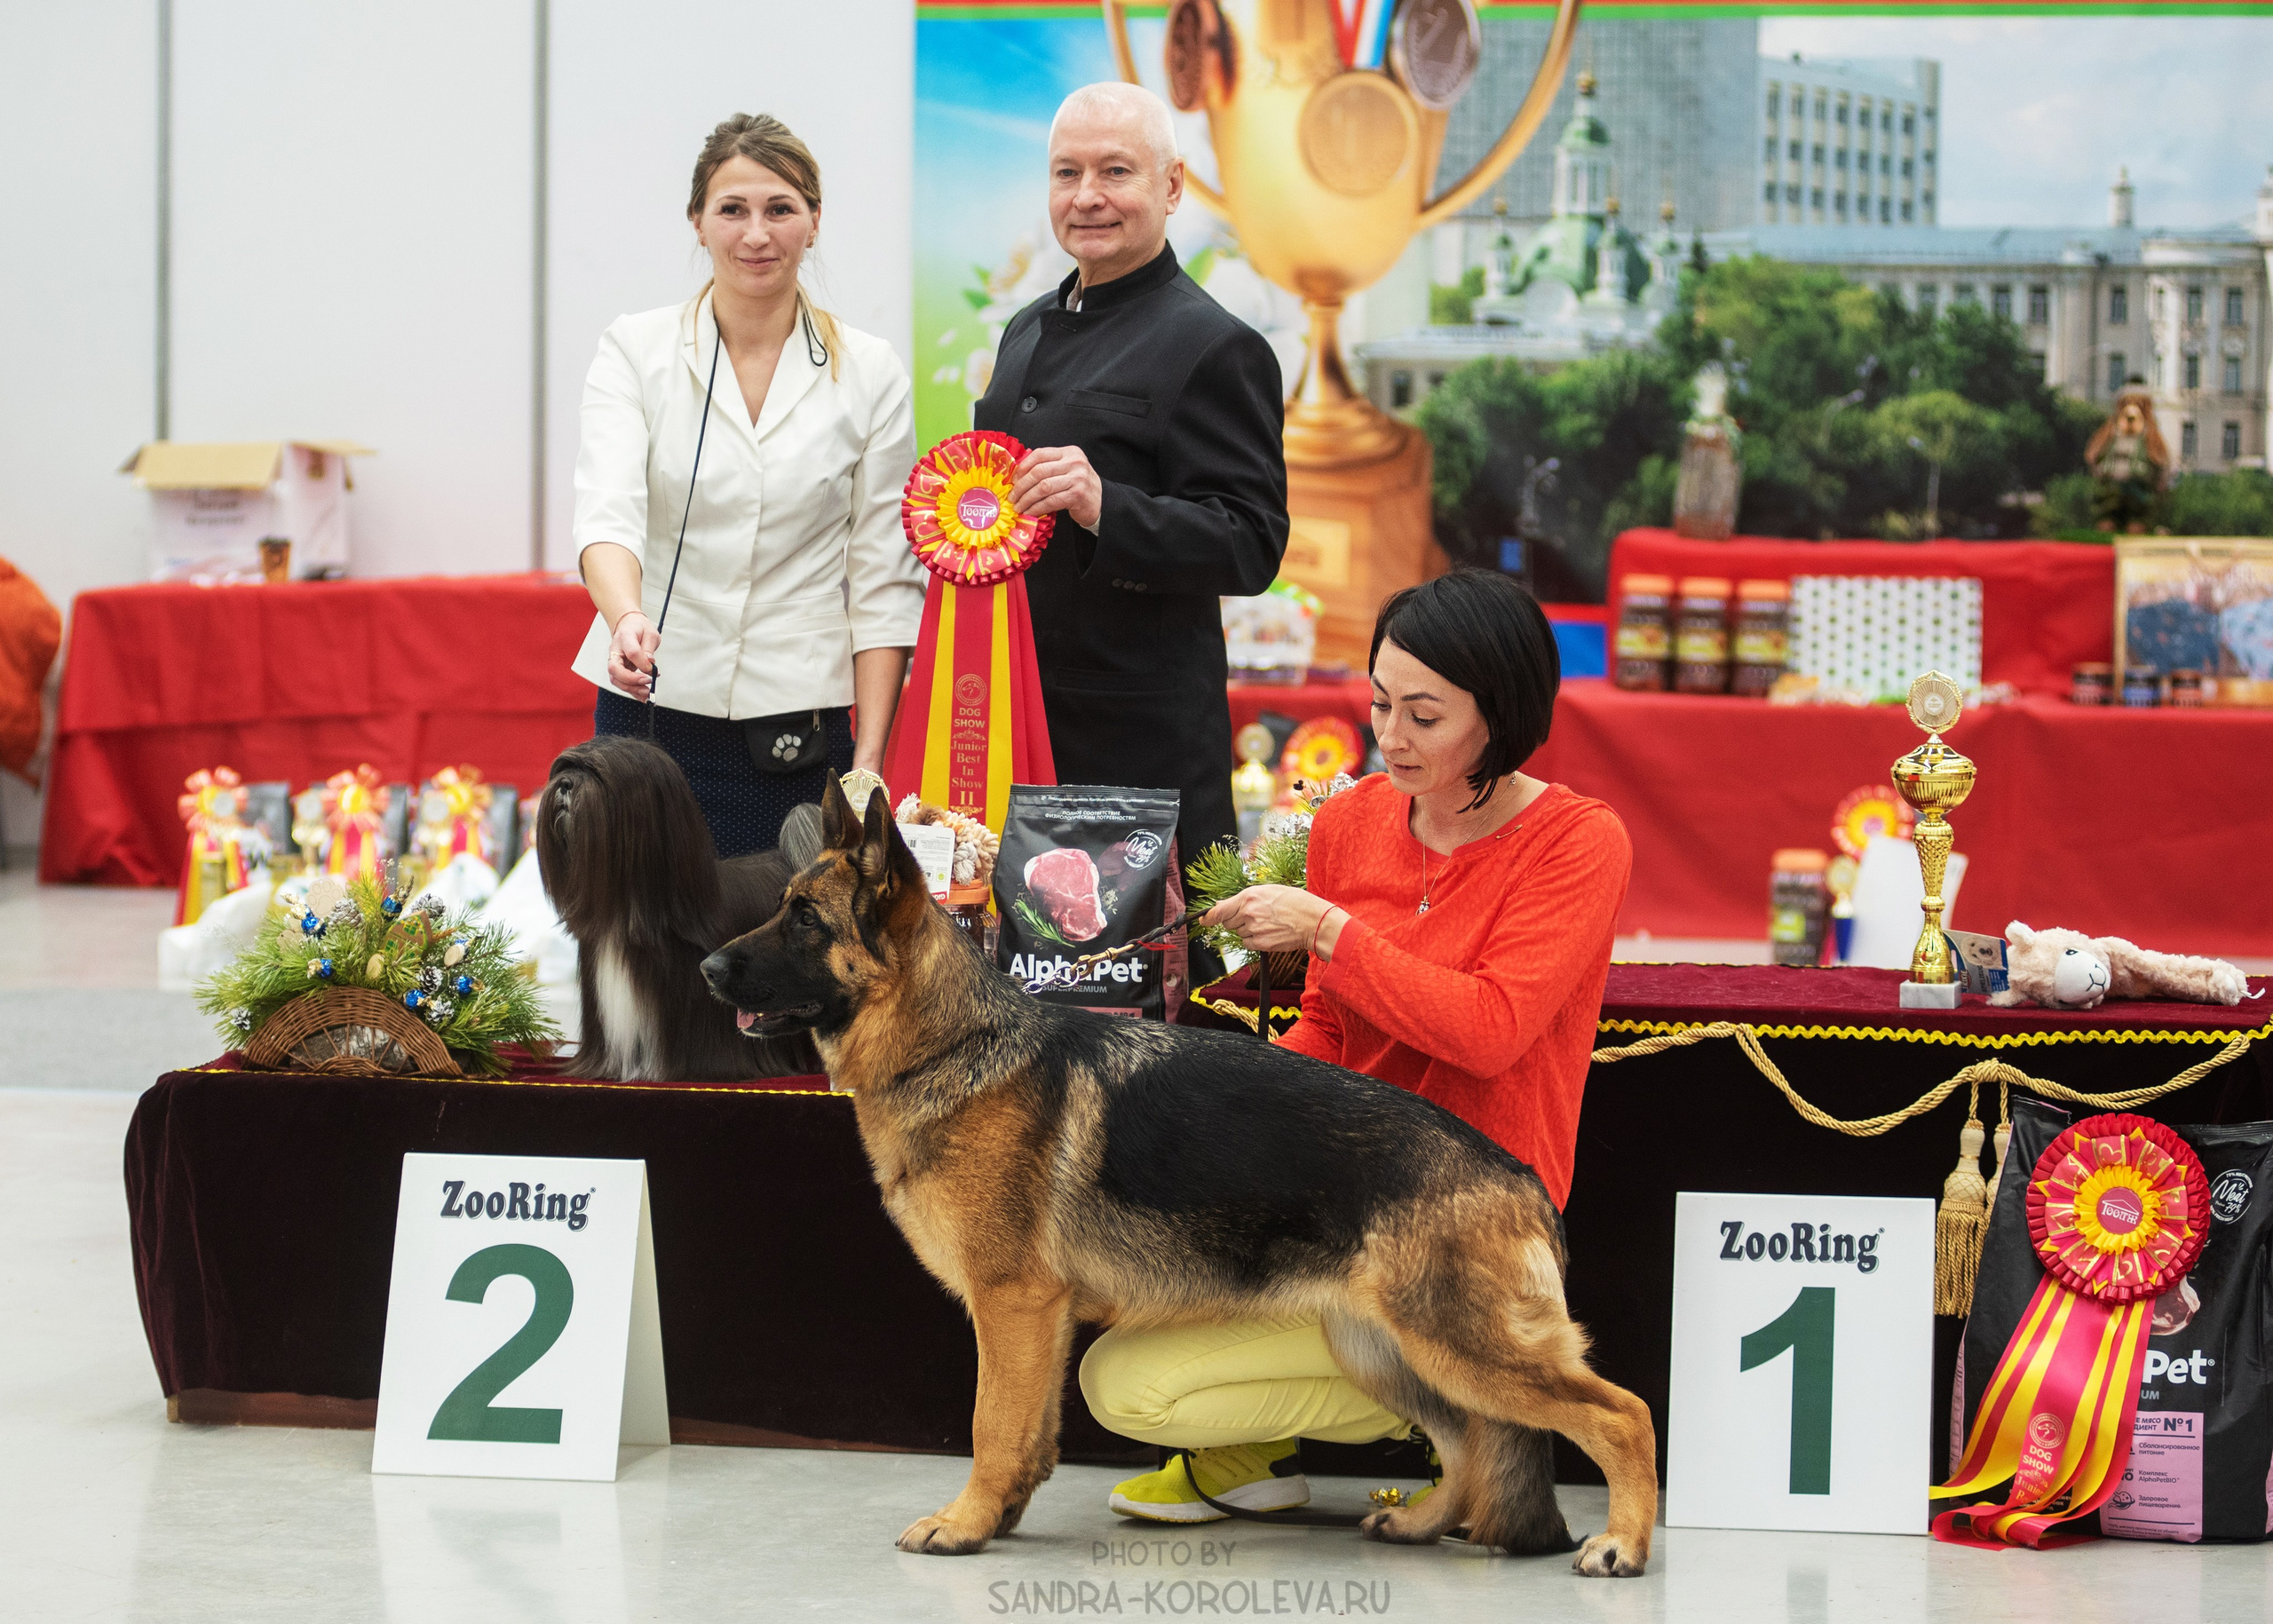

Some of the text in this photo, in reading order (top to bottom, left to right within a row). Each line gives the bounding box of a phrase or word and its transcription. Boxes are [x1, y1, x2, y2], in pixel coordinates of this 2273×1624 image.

[959, 708, 981, 717] DOG
[954, 718, 985, 728] SHOW
[951, 741, 987, 752] Junior
[956, 753, 981, 764] Best
[962, 765, 974, 776] In
[952, 778, 983, 788] Show
[2212, 1179, 2249, 1203] Meat
[440, 1180, 591, 1232] ZooRing
[1720, 1221, 1880, 1274] ZooRing
[426, 1243, 574, 1444] 2
[2142, 1350, 2207, 1384] Pet
[1740, 1287, 1835, 1495] 1
[2141, 1390, 2159, 1400] UM
[2029, 1445, 2053, 1462] DOG
[2022, 1454, 2055, 1474] SHOW
